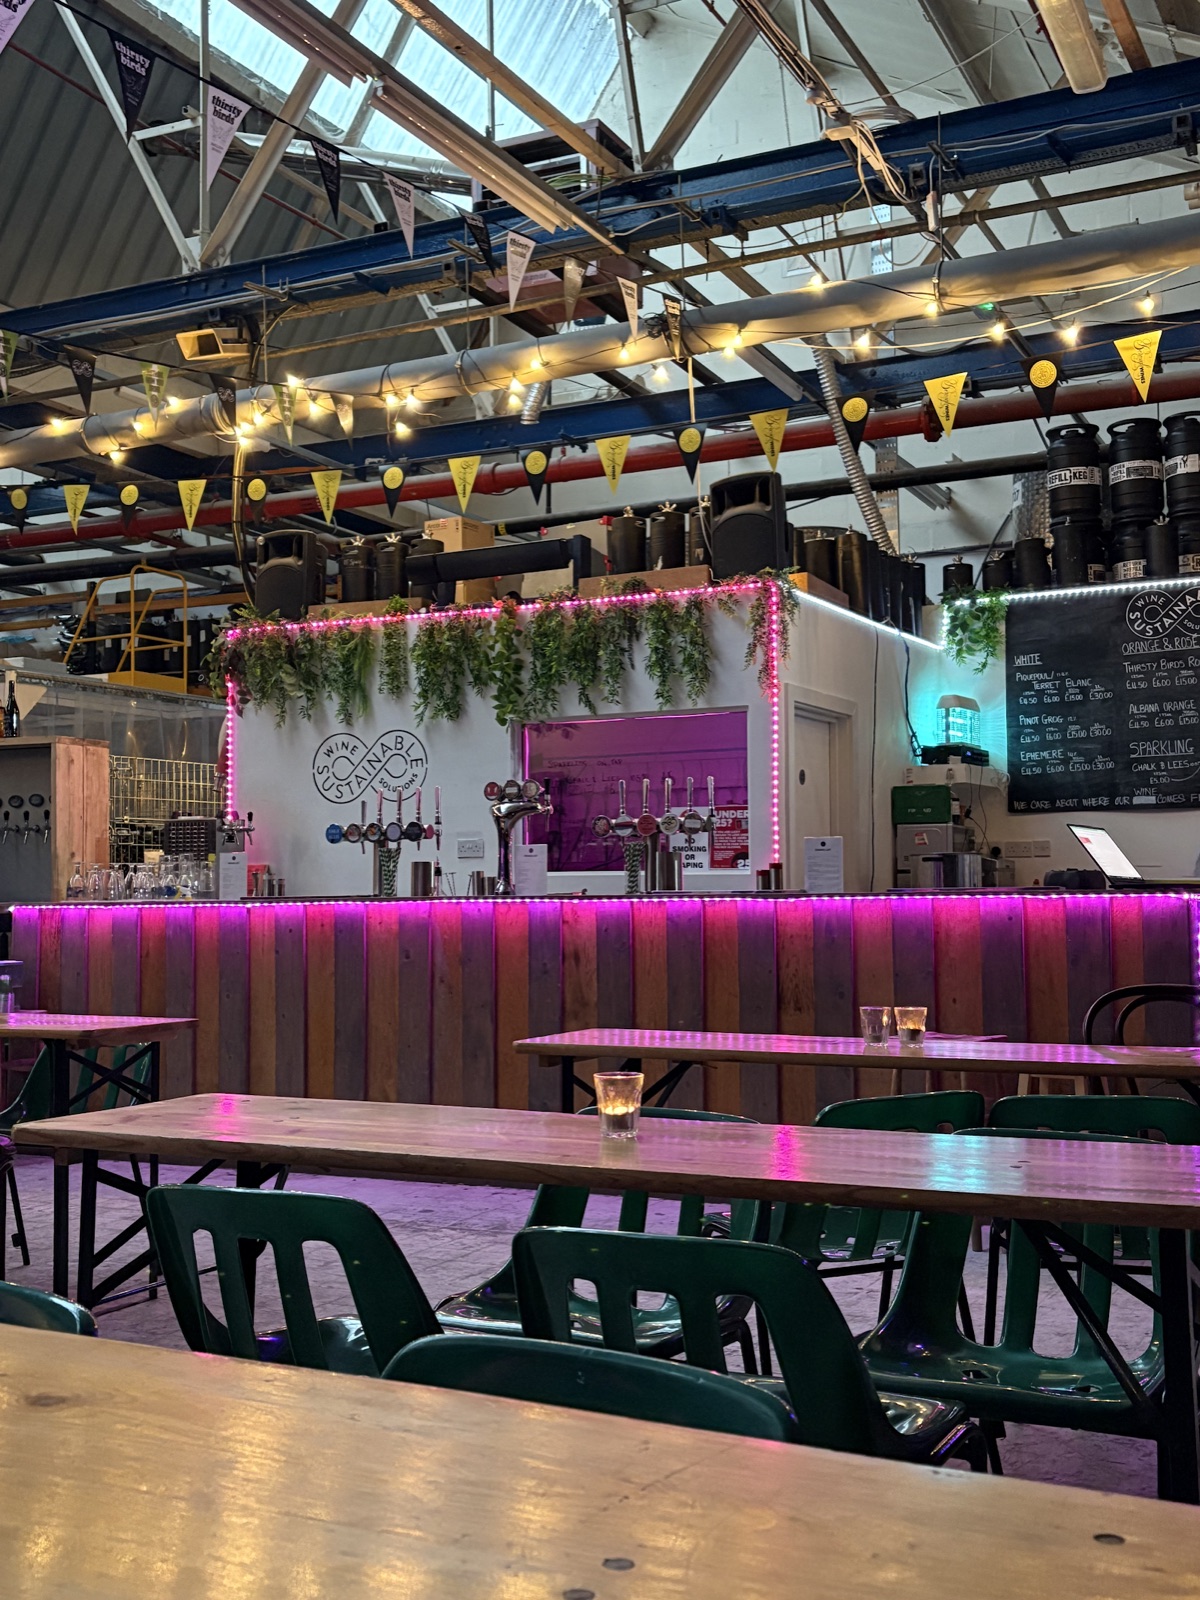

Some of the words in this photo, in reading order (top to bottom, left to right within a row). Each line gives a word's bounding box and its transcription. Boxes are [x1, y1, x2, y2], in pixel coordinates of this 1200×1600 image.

[114, 41, 151, 69] thirsty
[120, 53, 147, 77] birds
[211, 95, 243, 119] thirsty
[212, 106, 236, 126] birds
[1072, 470, 1088, 480] KEG
[1135, 594, 1166, 608] WINE
[1121, 639, 1160, 654] ORANGE
[1162, 637, 1173, 650] &
[1014, 653, 1041, 666] WHITE
[1123, 661, 1158, 673] THIRSTY
[1160, 658, 1186, 670] BIRDS
[1032, 681, 1061, 690] TERRET
[1065, 678, 1093, 688] BLANC
[1129, 702, 1160, 714] ALBANA
[1163, 700, 1197, 711] ORANGE
[1019, 714, 1040, 726] PINOT
[323, 741, 359, 758] WINE
[1020, 748, 1065, 762] EPHEMERE
[1129, 739, 1195, 757] SPARKLING
[317, 735, 424, 799] SUSTAINABLE
[1132, 762, 1157, 772] CHALK
[1168, 759, 1190, 770] LEES
[1014, 801, 1030, 810] WE
[1030, 800, 1051, 809] CARE
[1056, 798, 1078, 808] ABOUT
[1082, 796, 1110, 807] WHERE
[1115, 796, 1130, 805] OUR
[1134, 787, 1158, 796] WINE
[1157, 793, 1186, 804] COMES
[714, 810, 748, 819] UNDER
[672, 845, 707, 853] SMOKING
[684, 853, 696, 861] OR
